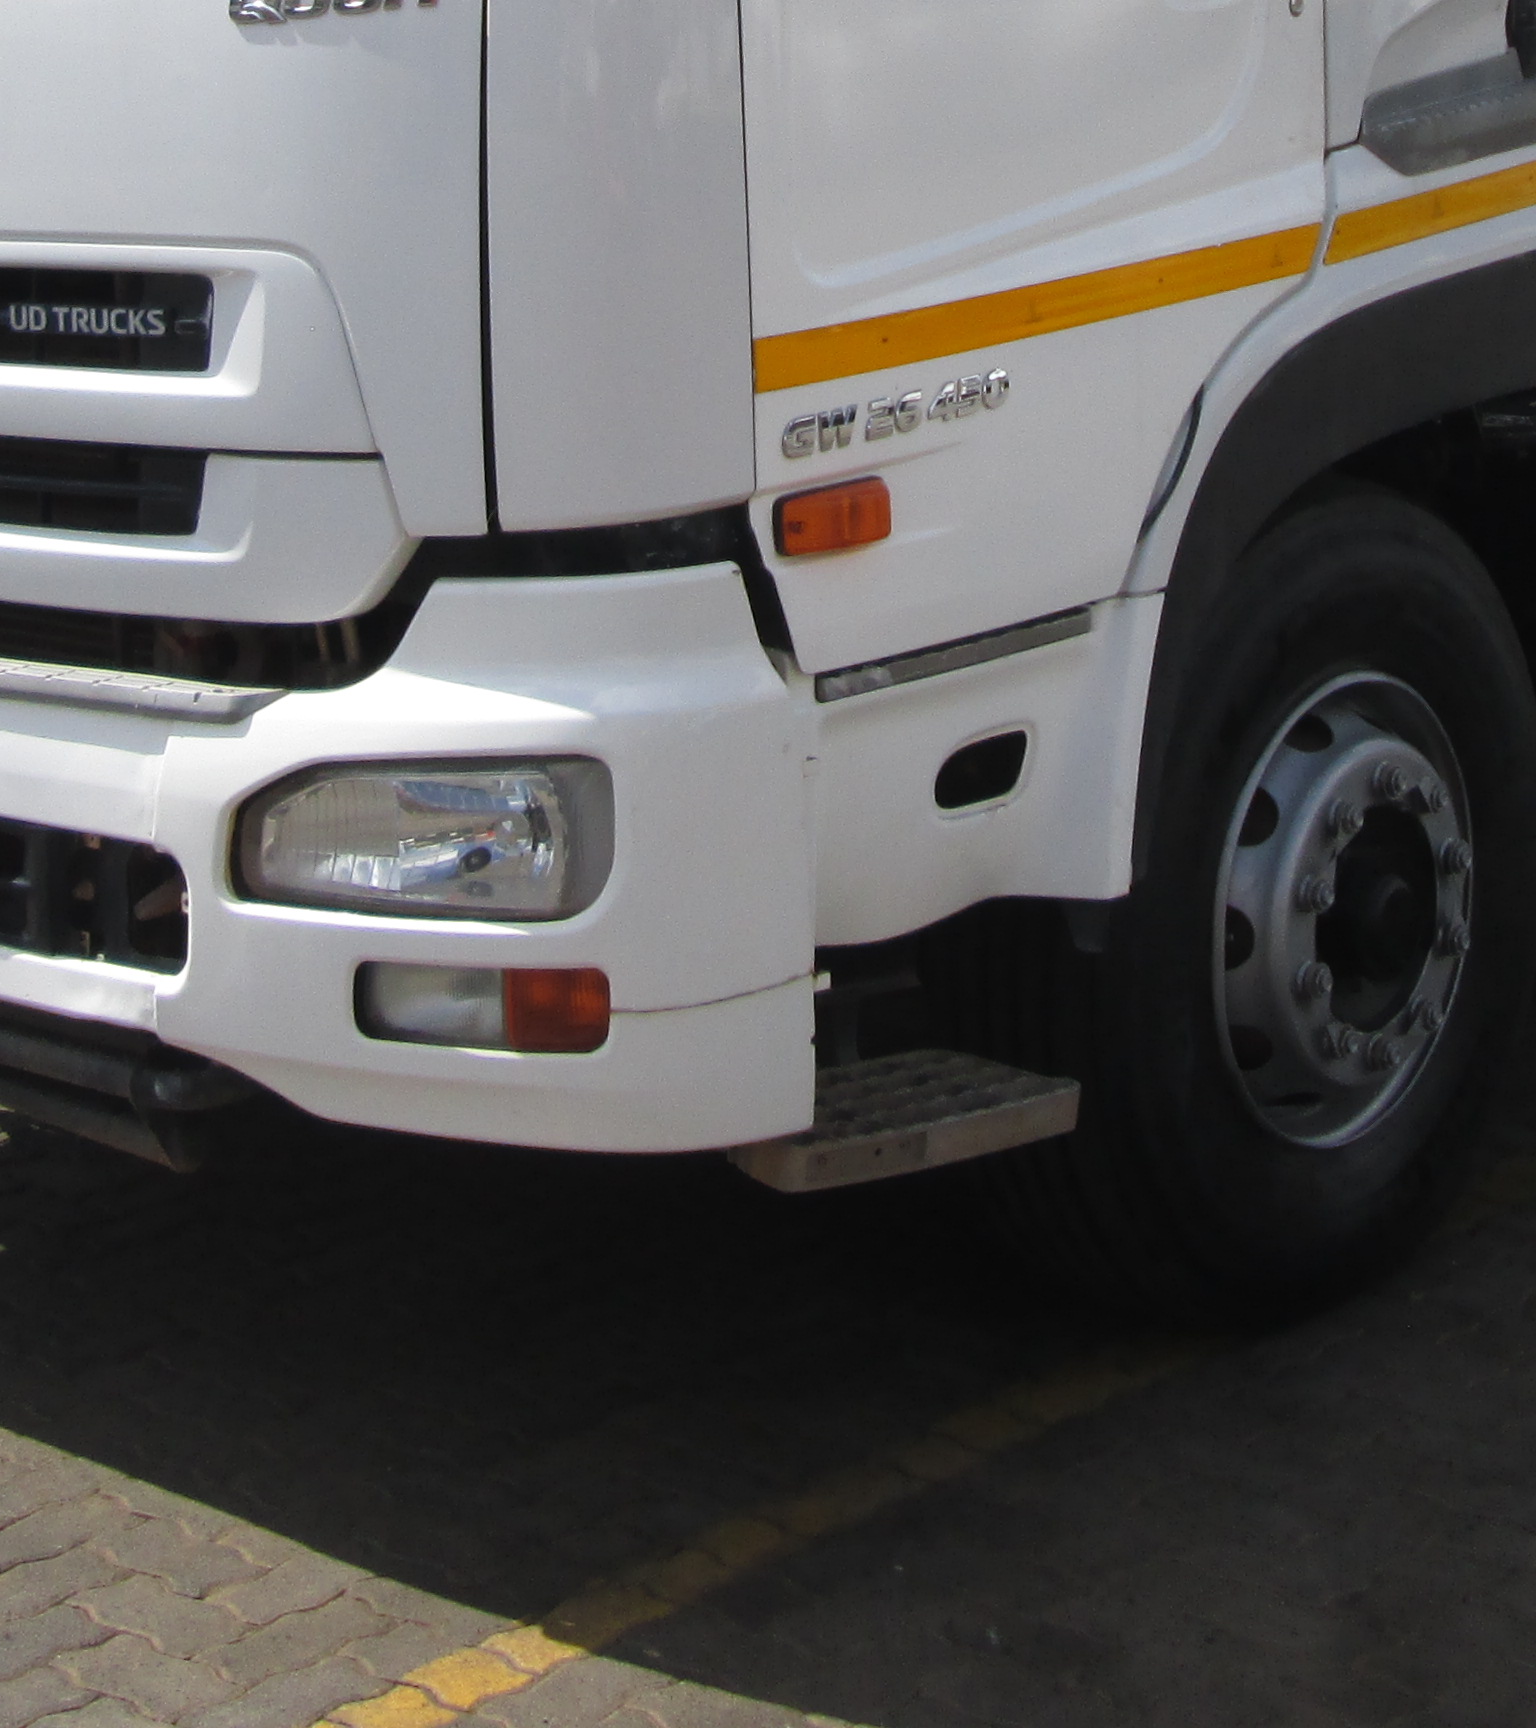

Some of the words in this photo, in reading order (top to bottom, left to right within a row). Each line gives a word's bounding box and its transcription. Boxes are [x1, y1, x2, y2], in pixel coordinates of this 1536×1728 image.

[8, 303, 48, 333] UD
[51, 306, 166, 337] TRUCKS
[780, 403, 859, 460] GW
[864, 388, 924, 442] 26
